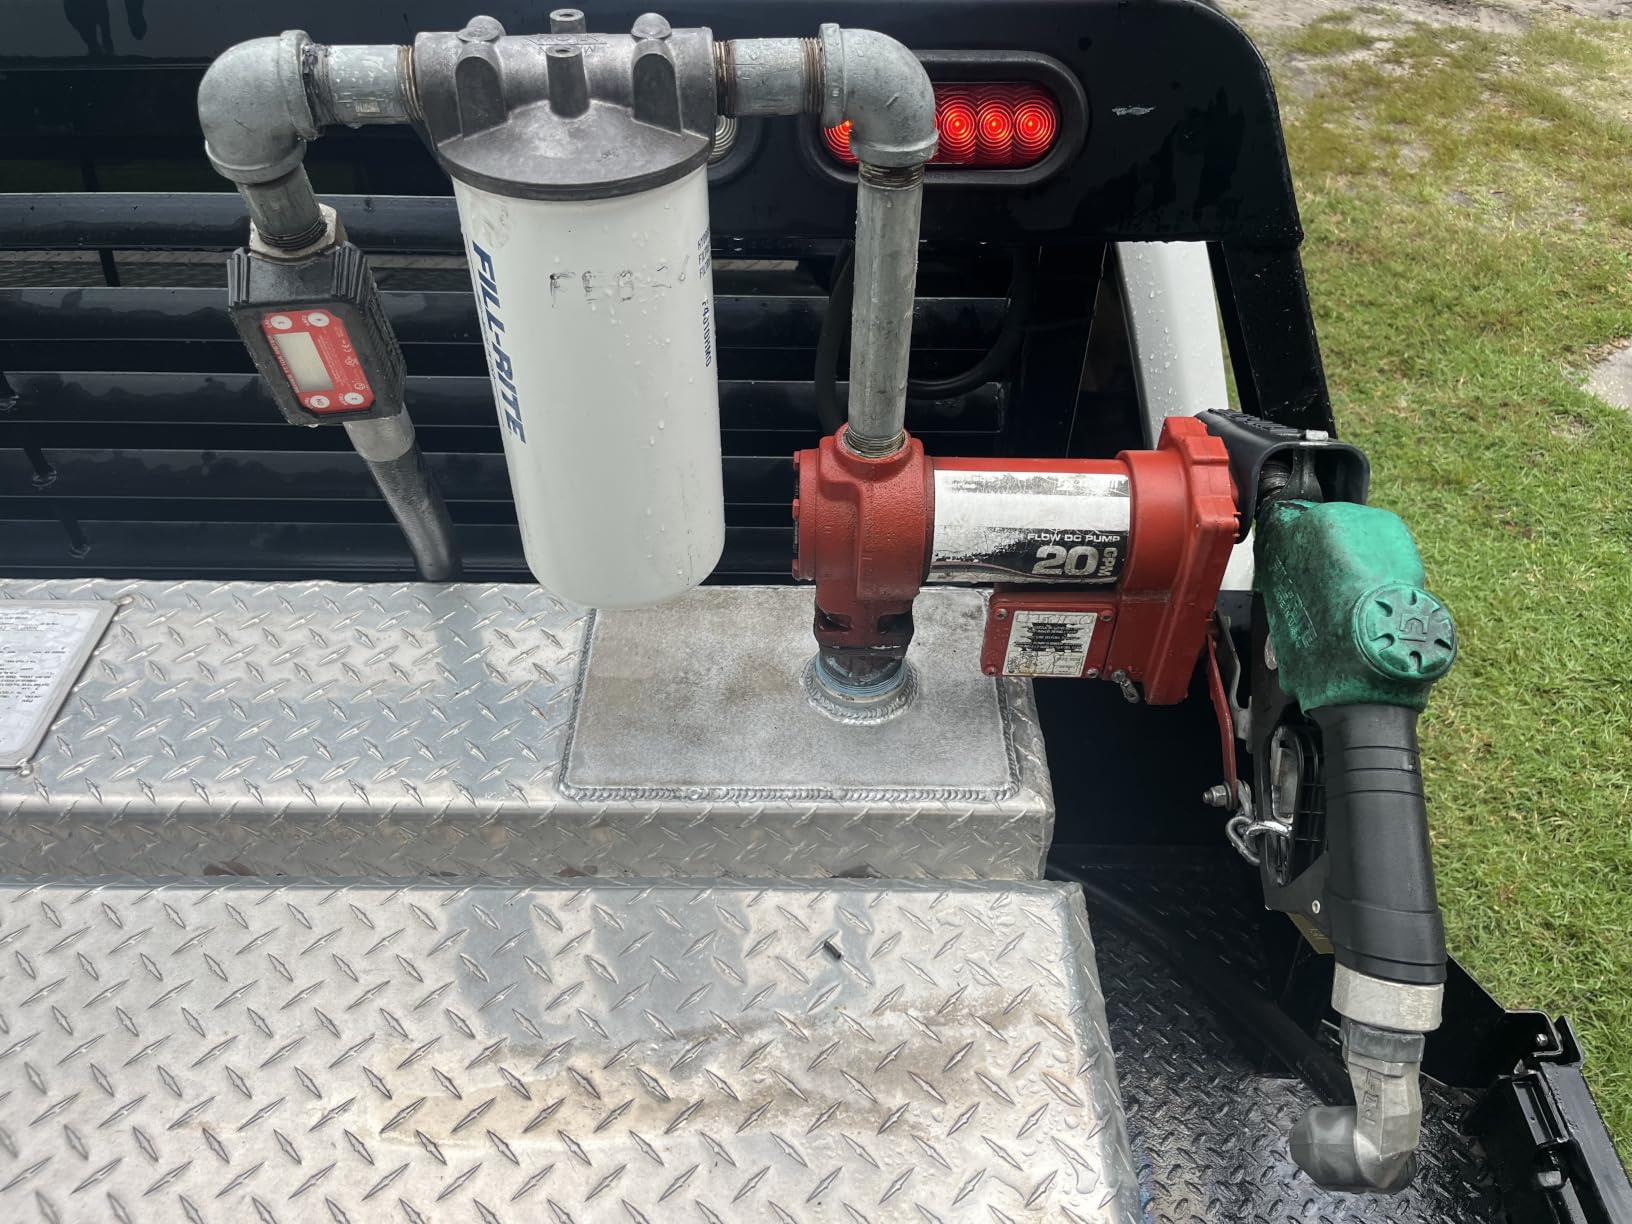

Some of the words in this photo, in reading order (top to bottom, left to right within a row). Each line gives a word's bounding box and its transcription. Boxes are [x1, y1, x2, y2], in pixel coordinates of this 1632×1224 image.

[472, 240, 526, 444] FILL-RITE
[1027, 533, 1061, 541] FLOW
[1032, 545, 1099, 576] 20
[1097, 547, 1118, 576] GPM
